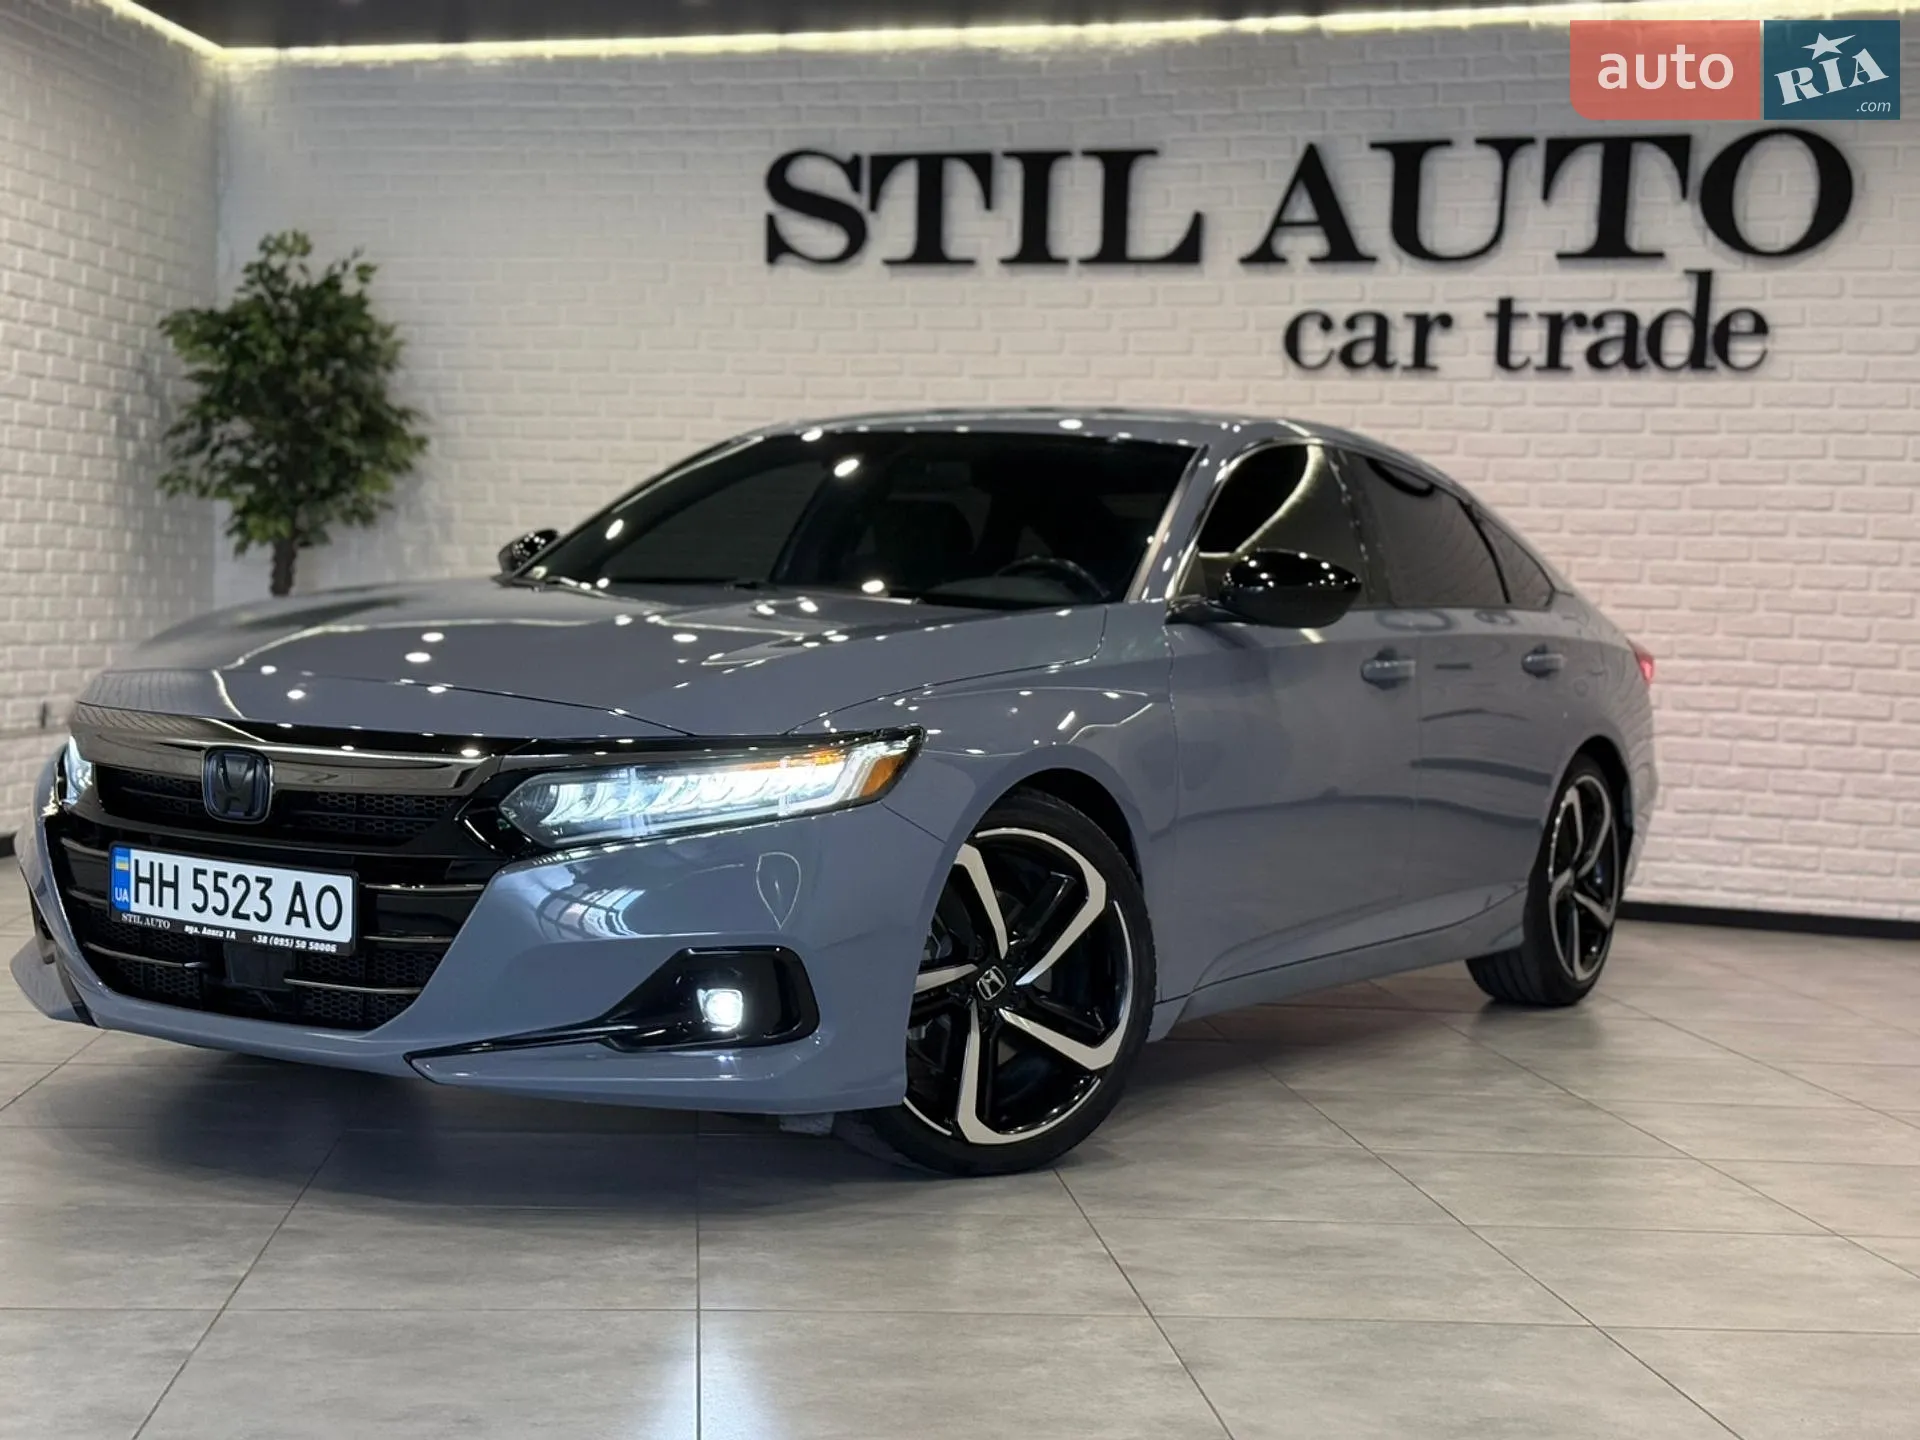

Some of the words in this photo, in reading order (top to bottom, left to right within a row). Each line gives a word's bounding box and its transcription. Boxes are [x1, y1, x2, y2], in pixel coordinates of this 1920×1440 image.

[764, 148, 1204, 266] STIL
[1240, 126, 1855, 265] AUTO
[1283, 304, 1453, 373] car
[1486, 269, 1770, 373] trade
[114, 887, 129, 902] UA
[121, 912, 143, 925] STIL
[144, 917, 171, 929] AUTO
[133, 858, 179, 910] HH
[191, 867, 273, 923] 5523
[285, 881, 343, 931] AO
